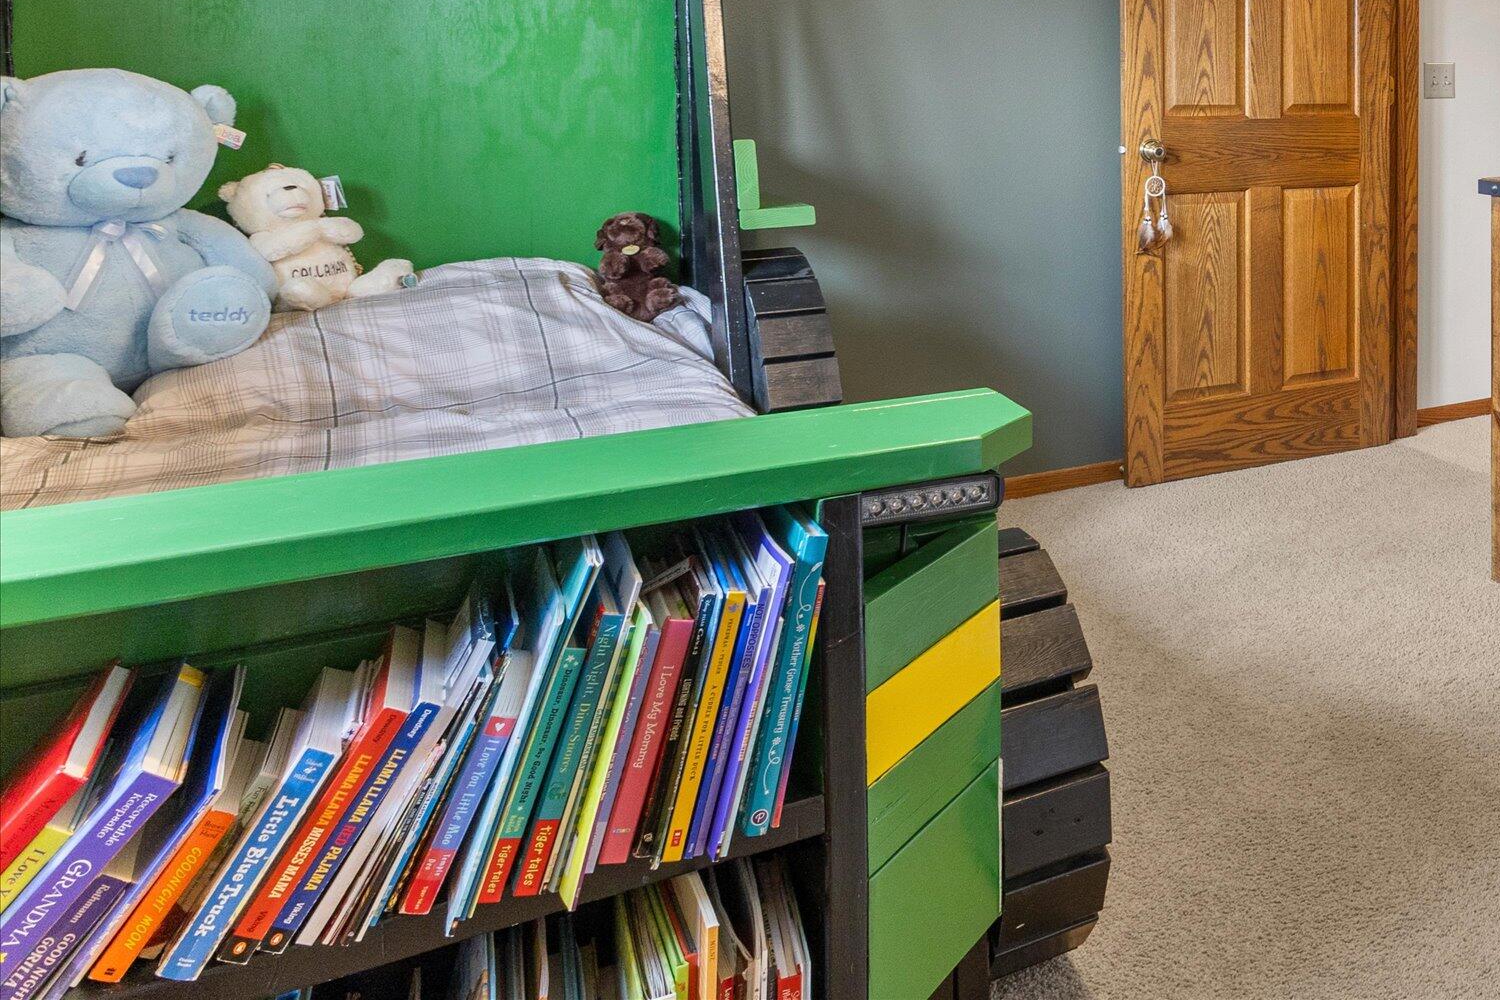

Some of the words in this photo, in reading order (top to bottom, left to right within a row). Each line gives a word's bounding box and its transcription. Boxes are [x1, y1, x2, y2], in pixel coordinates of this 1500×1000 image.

[188, 306, 250, 325] teddy
[755, 602, 766, 623] NOT
[596, 624, 618, 658] Night
[741, 621, 762, 669] OPPOSITES
[791, 634, 804, 666] Mother
[655, 670, 674, 701] Love
[782, 666, 798, 695] Goose
[647, 700, 664, 721] My
[773, 694, 793, 735] Treasury
[476, 744, 497, 770] Love
[560, 702, 591, 775] Dino-Snores
[632, 720, 659, 770] Mommy
[341, 753, 373, 790] LLAMA
[373, 748, 408, 792] LLAMA
[526, 758, 541, 781] Good
[688, 761, 700, 783] DUCK
[96, 791, 144, 840] Keepsake
[104, 791, 159, 848] Recordable
[256, 793, 301, 844] Little
[316, 791, 346, 832] LLAMA
[348, 786, 380, 824] LLAMA
[452, 792, 476, 824] Little
[290, 827, 323, 867] MISSES
[442, 824, 462, 846] Moo
[533, 824, 554, 861] tiger
[6, 856, 42, 886] Love
[231, 845, 269, 884] Blue
[303, 845, 344, 893] PAJAMA
[497, 843, 513, 872] tiger
[522, 857, 544, 887] tales
[151, 845, 203, 915] GOODNIGHT
[267, 863, 300, 900] MAMA
[486, 869, 503, 896] tales
[1, 859, 93, 948] GRANDMA
[68, 883, 112, 925] Rothmann
[193, 882, 245, 938] Truck
[283, 902, 306, 926] Viking
[43, 932, 77, 967] GOOD
[123, 915, 155, 952] MOON
[3, 936, 55, 988] GORILLA
